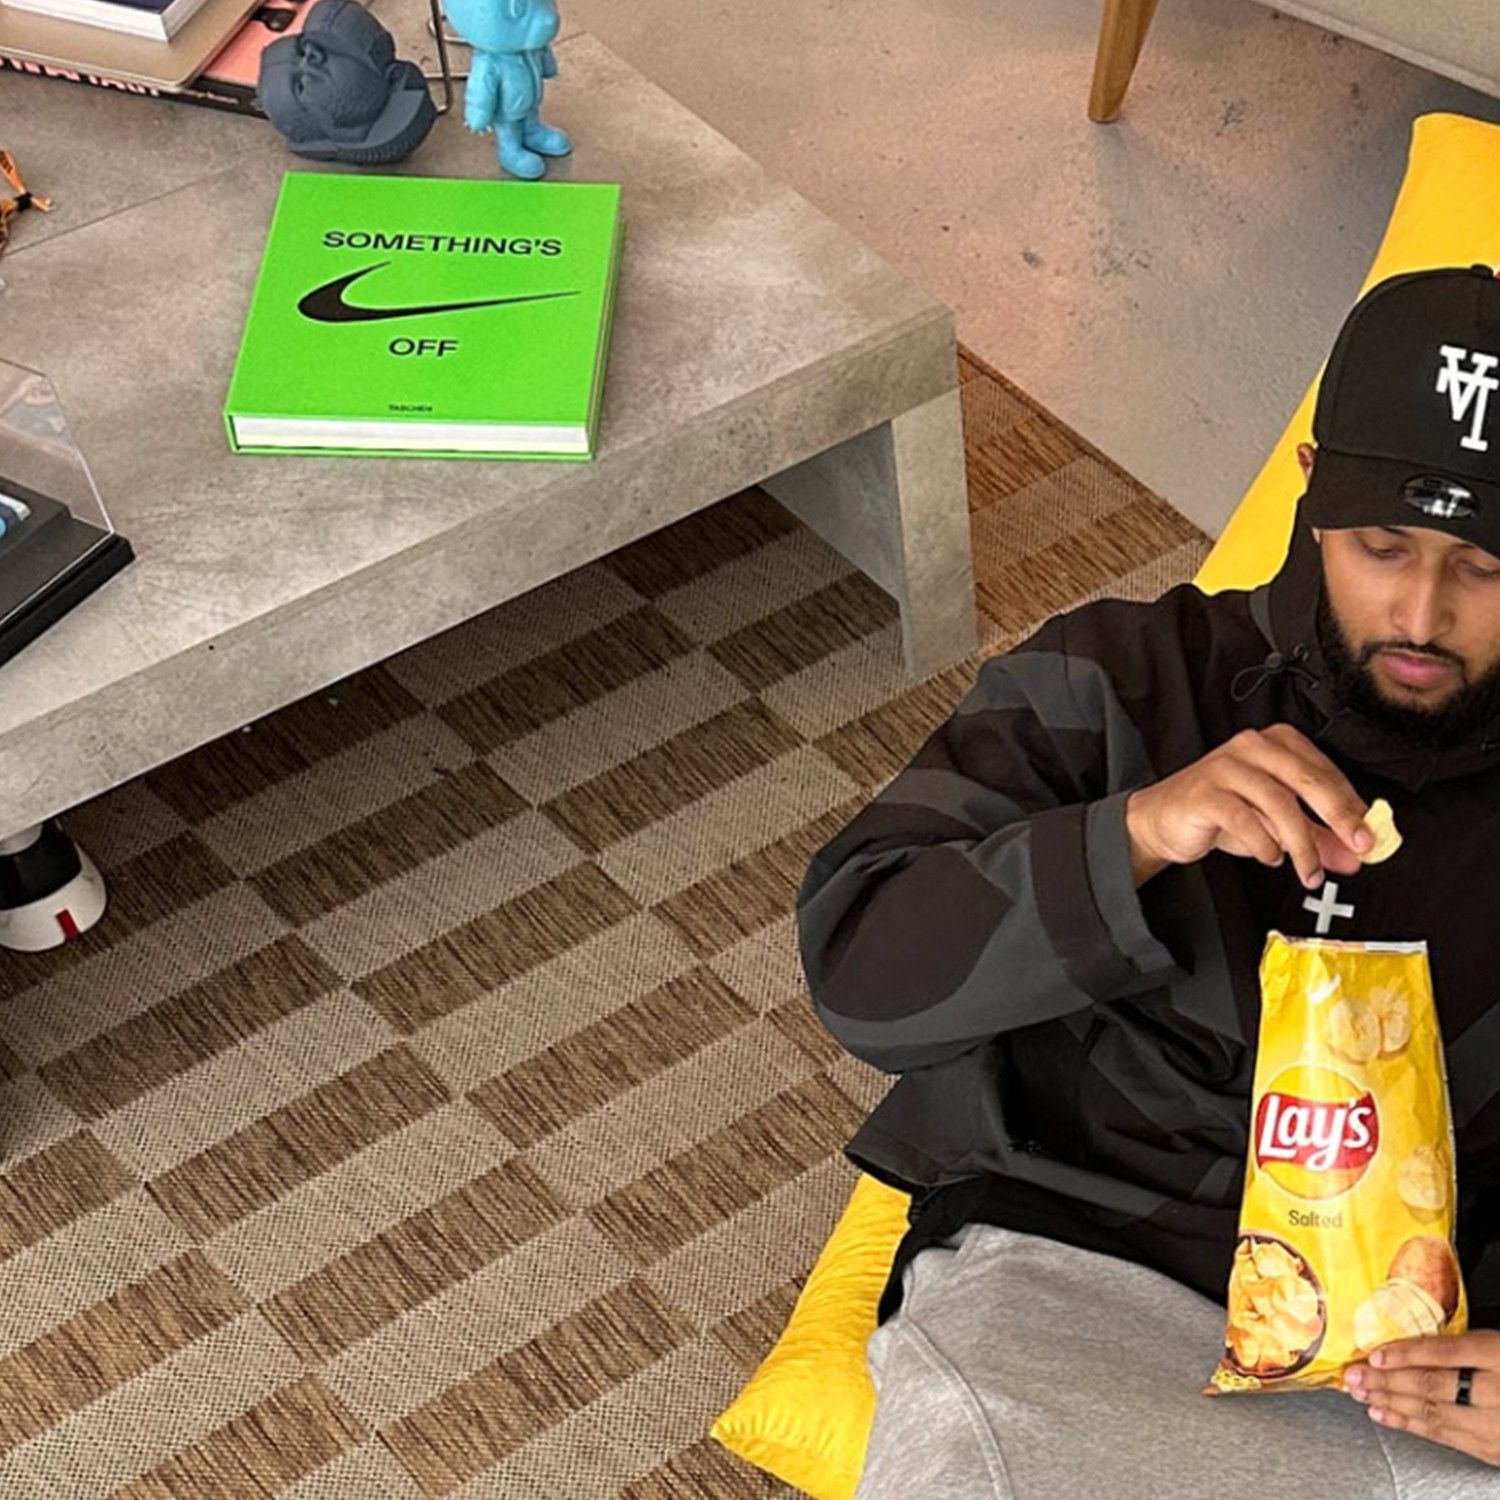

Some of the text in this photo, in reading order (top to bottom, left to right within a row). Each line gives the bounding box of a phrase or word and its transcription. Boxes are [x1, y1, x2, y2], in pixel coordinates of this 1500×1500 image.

[323, 231, 562, 256] SOMETHING'S
[388, 338, 459, 357] OFF
[1258, 1095, 1372, 1172] Lay's
[1288, 1209, 1344, 1228] Salted
